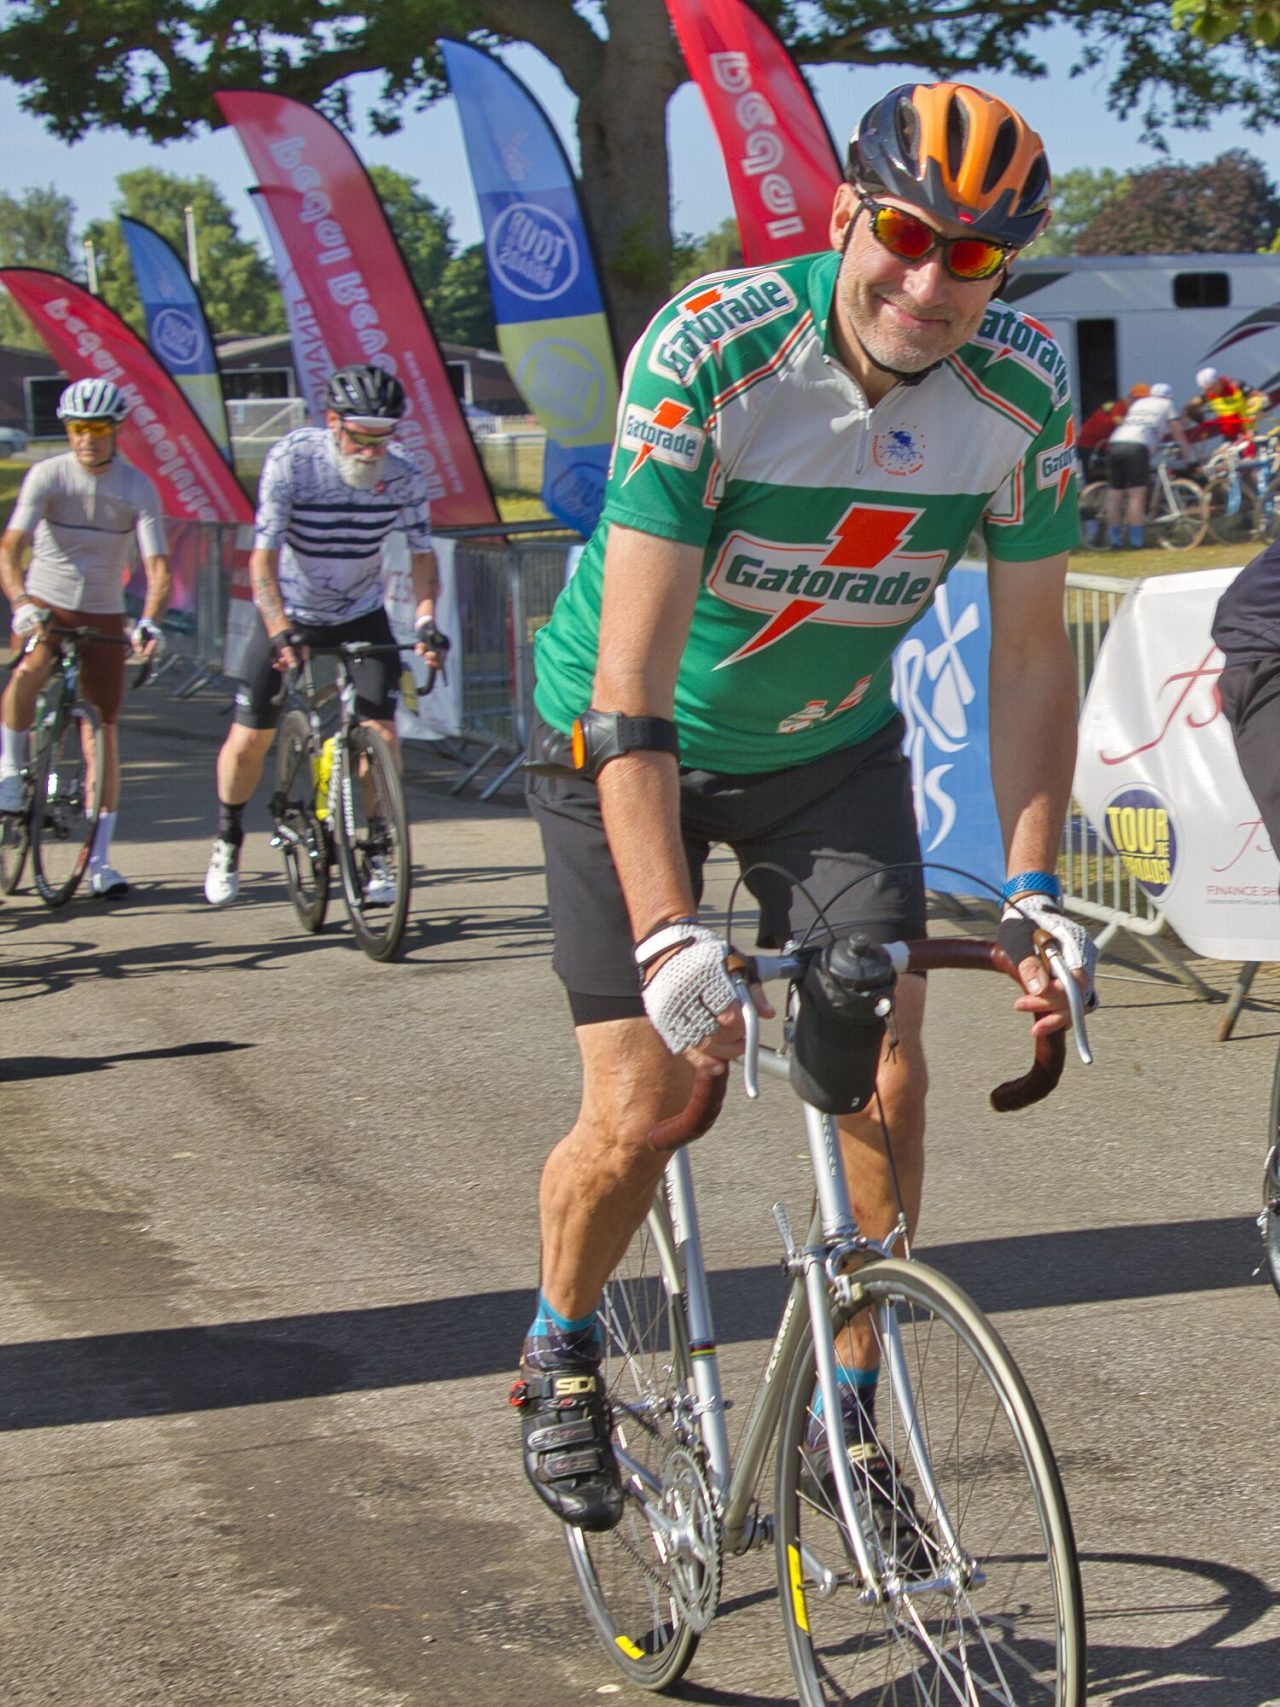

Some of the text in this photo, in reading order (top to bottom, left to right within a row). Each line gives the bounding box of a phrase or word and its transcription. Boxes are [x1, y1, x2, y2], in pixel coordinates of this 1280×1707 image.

[657, 280, 790, 380] Gatorade
[976, 308, 1069, 400] atorade
[724, 553, 932, 606] Gatorade
[1104, 806, 1169, 854] TOUR
